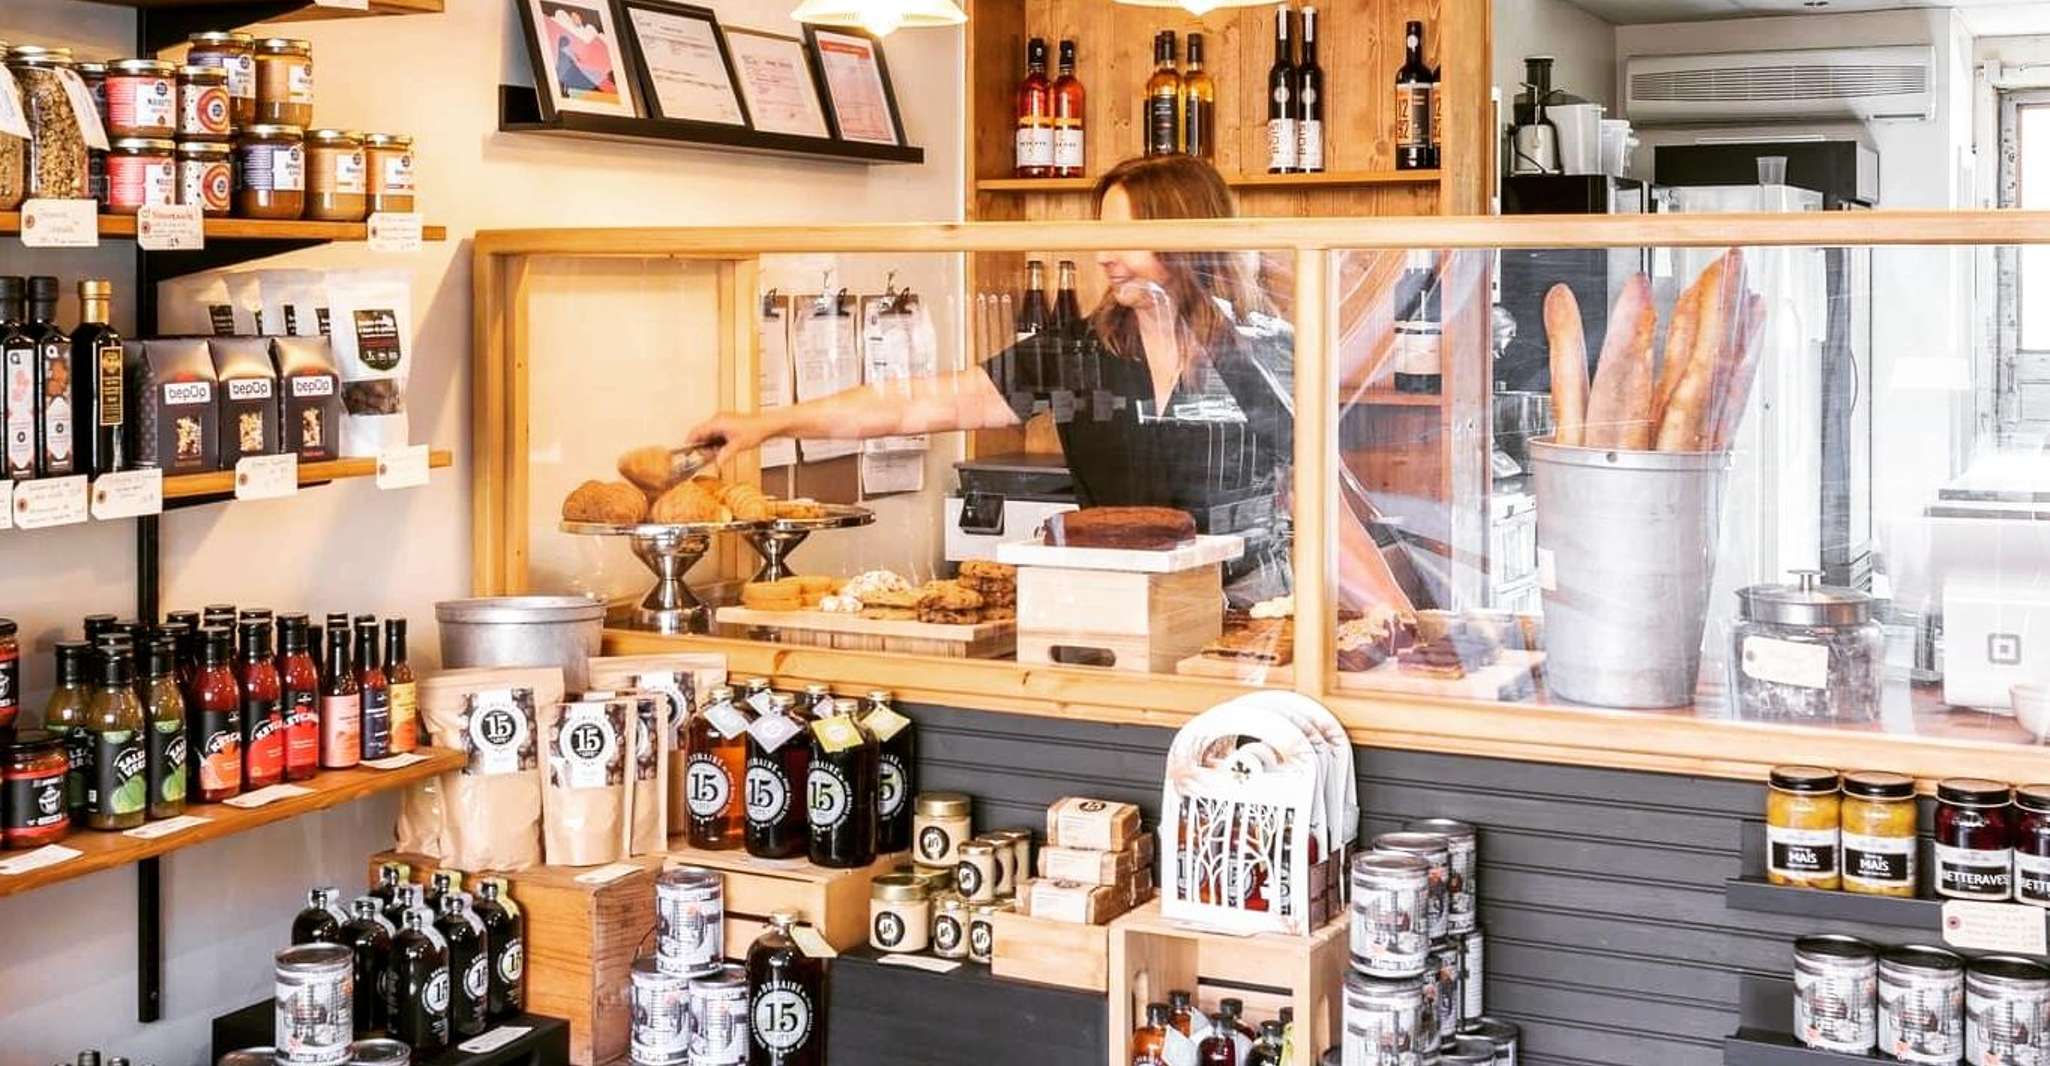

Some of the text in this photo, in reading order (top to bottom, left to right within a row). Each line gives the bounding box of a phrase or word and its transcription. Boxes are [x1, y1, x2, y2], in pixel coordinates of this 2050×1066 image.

[485, 714, 513, 740] 15
[572, 727, 601, 753] 15
[690, 773, 719, 802] 15
[748, 778, 774, 808] 15
[809, 781, 834, 812] 15
[764, 1002, 799, 1033] 15
